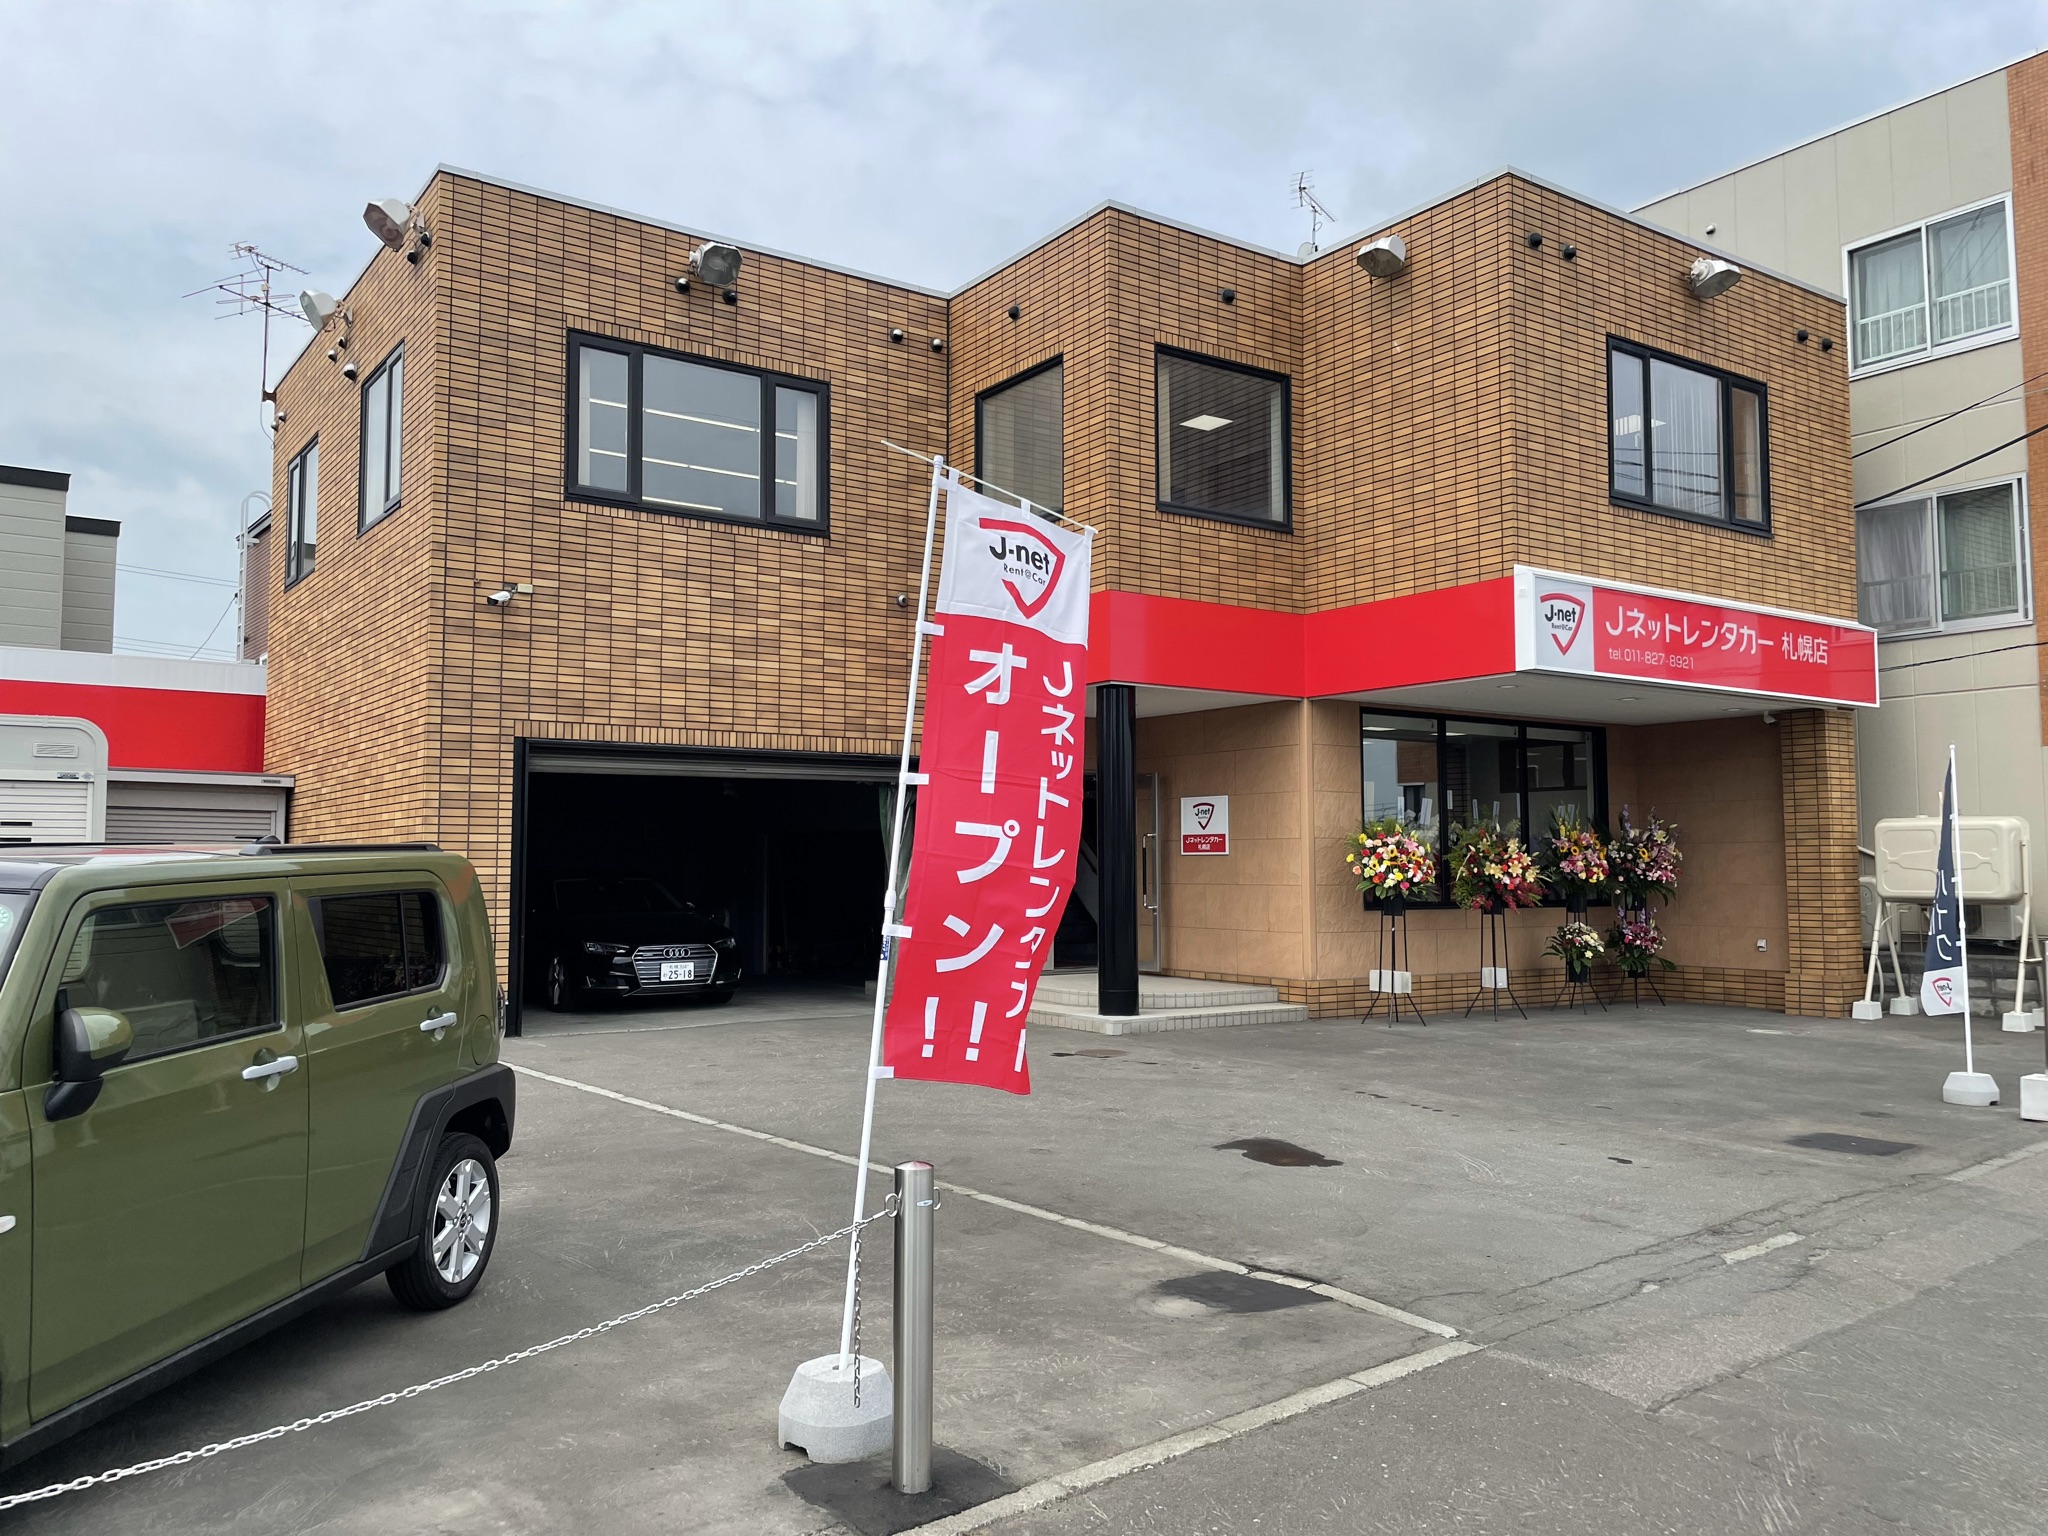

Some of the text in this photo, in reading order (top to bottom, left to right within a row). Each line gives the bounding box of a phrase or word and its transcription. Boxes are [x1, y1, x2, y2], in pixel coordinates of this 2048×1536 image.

[1003, 563, 1046, 586] Rent@Car
[1605, 606, 1829, 666] Jネットレンタカー 札幌店
[668, 970, 692, 979] 25-18
